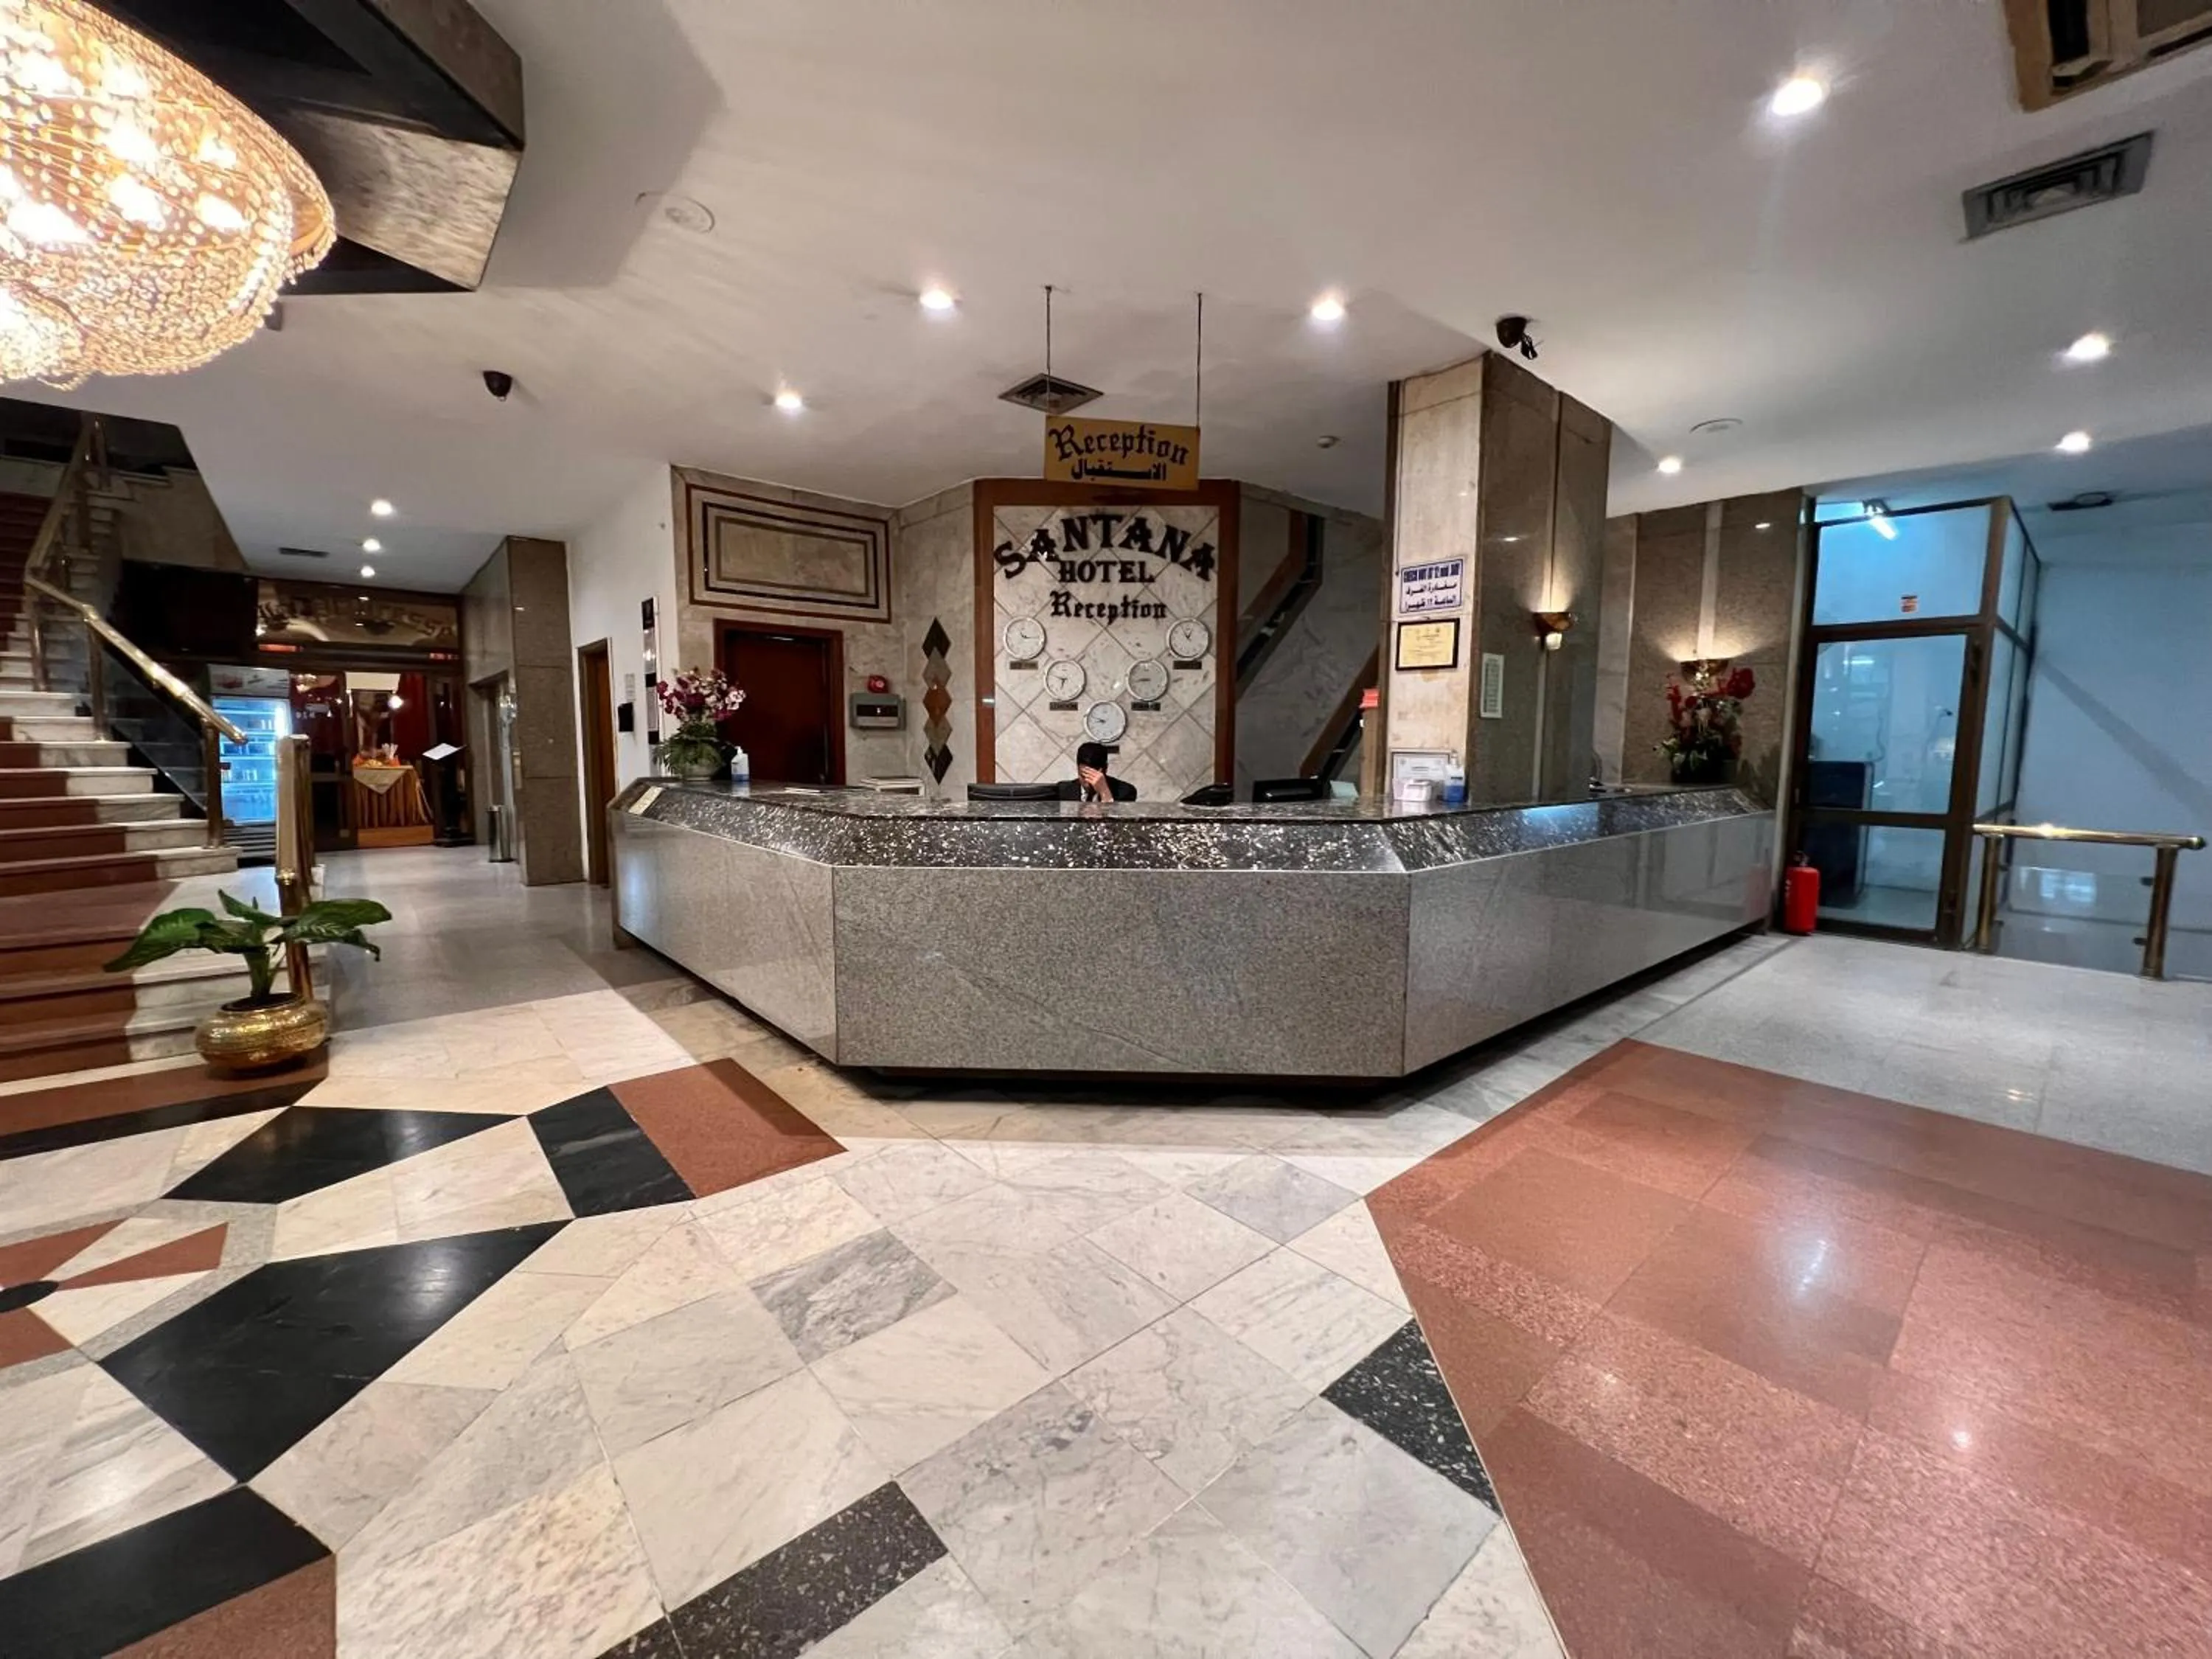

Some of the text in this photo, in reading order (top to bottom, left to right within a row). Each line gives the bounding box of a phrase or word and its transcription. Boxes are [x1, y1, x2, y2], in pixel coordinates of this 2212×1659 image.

[1048, 424, 1190, 465] Reception
[994, 513, 1215, 582] SANTANA
[1058, 560, 1155, 583] HOTEL
[1049, 591, 1167, 626] Reception
